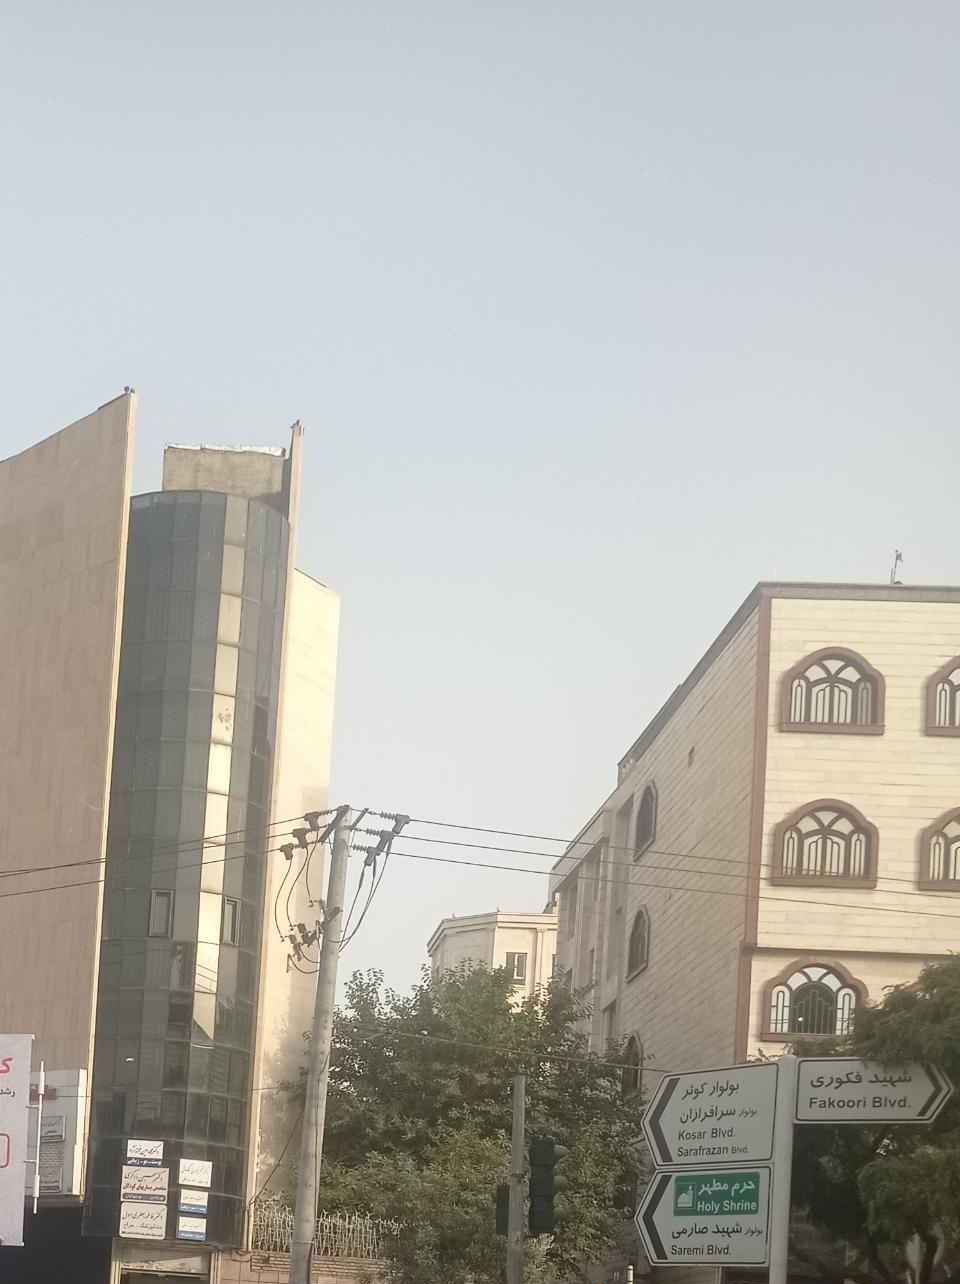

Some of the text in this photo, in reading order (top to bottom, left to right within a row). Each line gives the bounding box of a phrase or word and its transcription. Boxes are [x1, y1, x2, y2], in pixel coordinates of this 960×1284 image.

[810, 1070, 913, 1090] شهید فکوری
[0, 1087, 16, 1098] رشد
[681, 1080, 739, 1100] بولوار کوثر
[809, 1096, 912, 1108] Fakoori Blvd.
[680, 1105, 736, 1124] سرافرازان
[678, 1127, 736, 1141] Kosar Blvd.
[677, 1145, 728, 1157] Sarafrazan
[697, 1179, 755, 1196] حرم مطهر
[697, 1200, 757, 1214] Holy Shrine
[671, 1223, 708, 1239] صارمی
[711, 1221, 742, 1238] شهید
[670, 1244, 731, 1256] Saremi Blvd.
